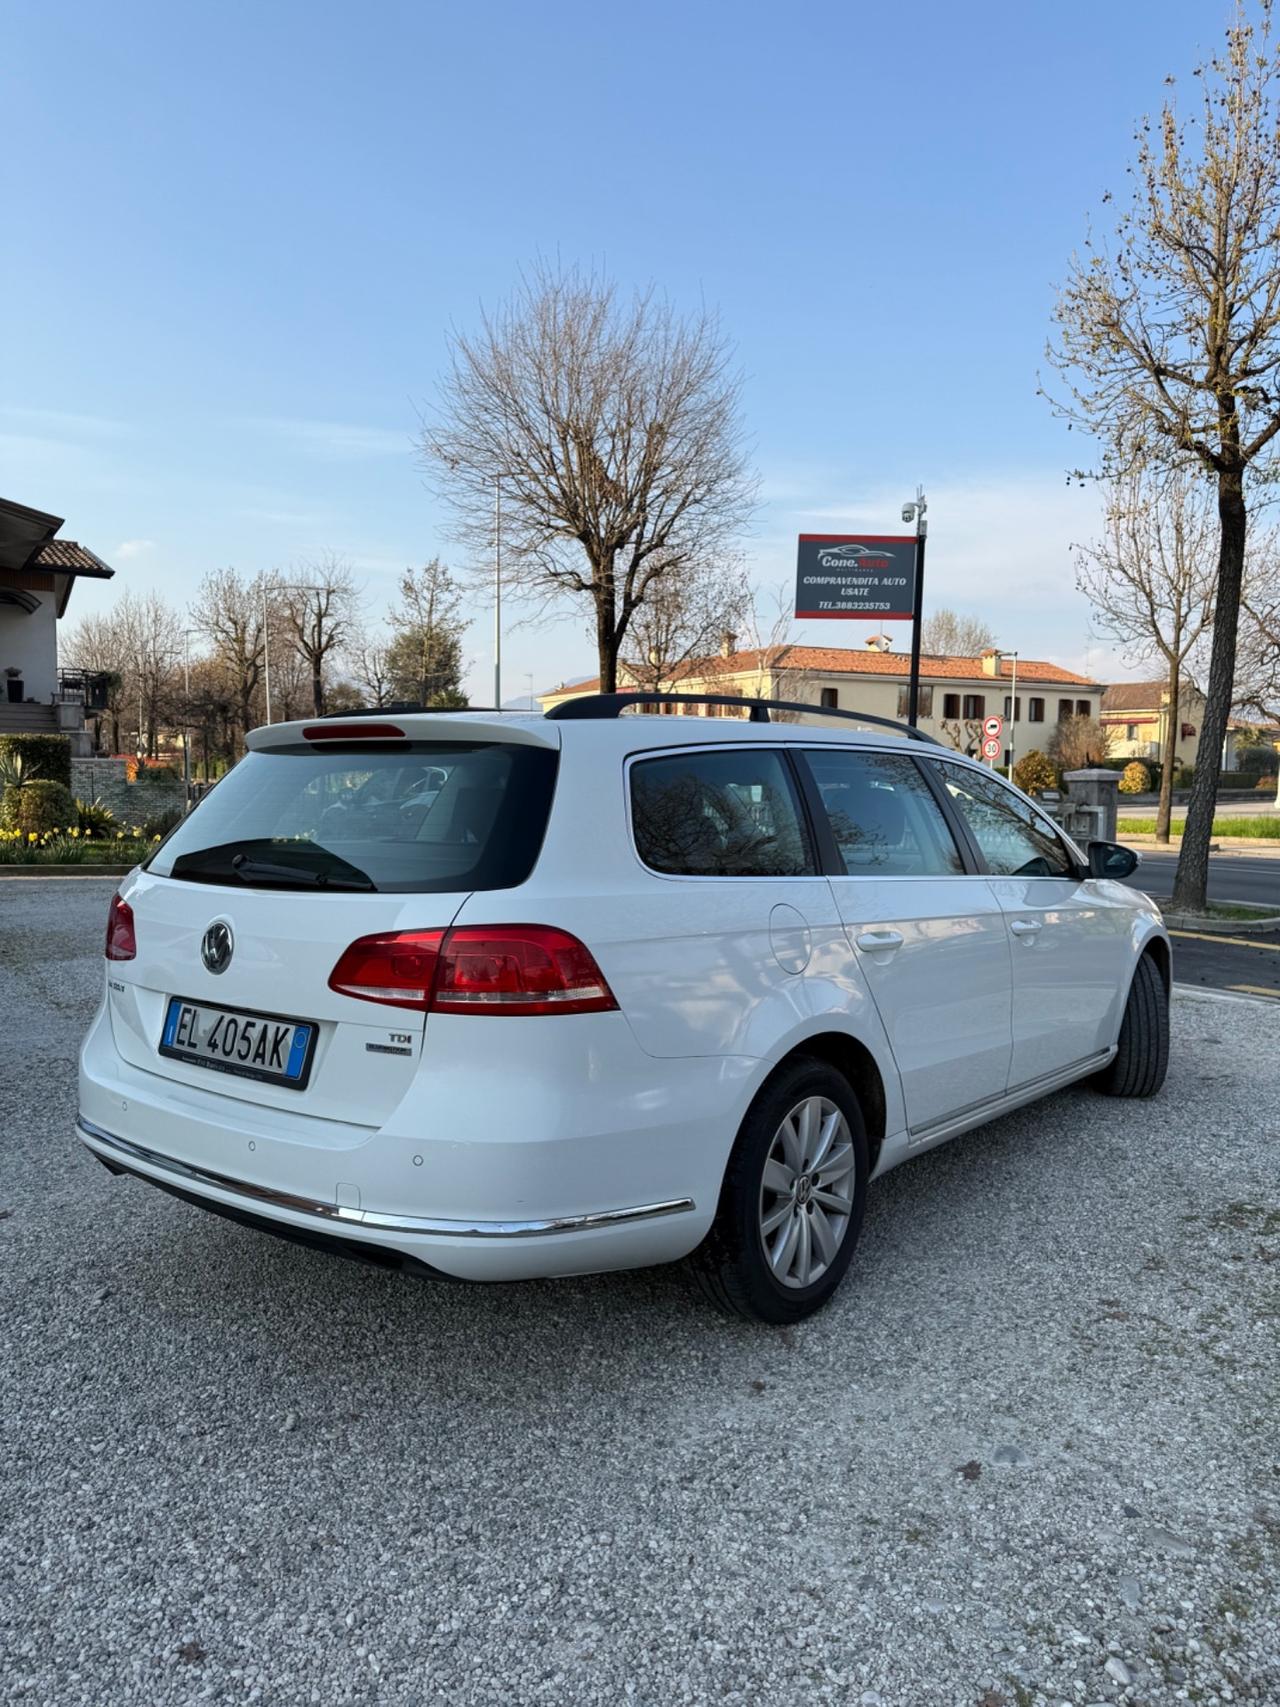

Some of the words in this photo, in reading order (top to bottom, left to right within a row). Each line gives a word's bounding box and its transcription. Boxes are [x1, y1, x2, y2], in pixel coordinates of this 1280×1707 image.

[803, 576, 879, 586] COMPRAVENDITA
[881, 577, 907, 586] AUTO
[841, 588, 870, 596] USATE
[987, 743, 997, 753] 30
[176, 1007, 199, 1049] EL
[207, 1015, 291, 1069] 405AK
[388, 1033, 412, 1044] TDI
